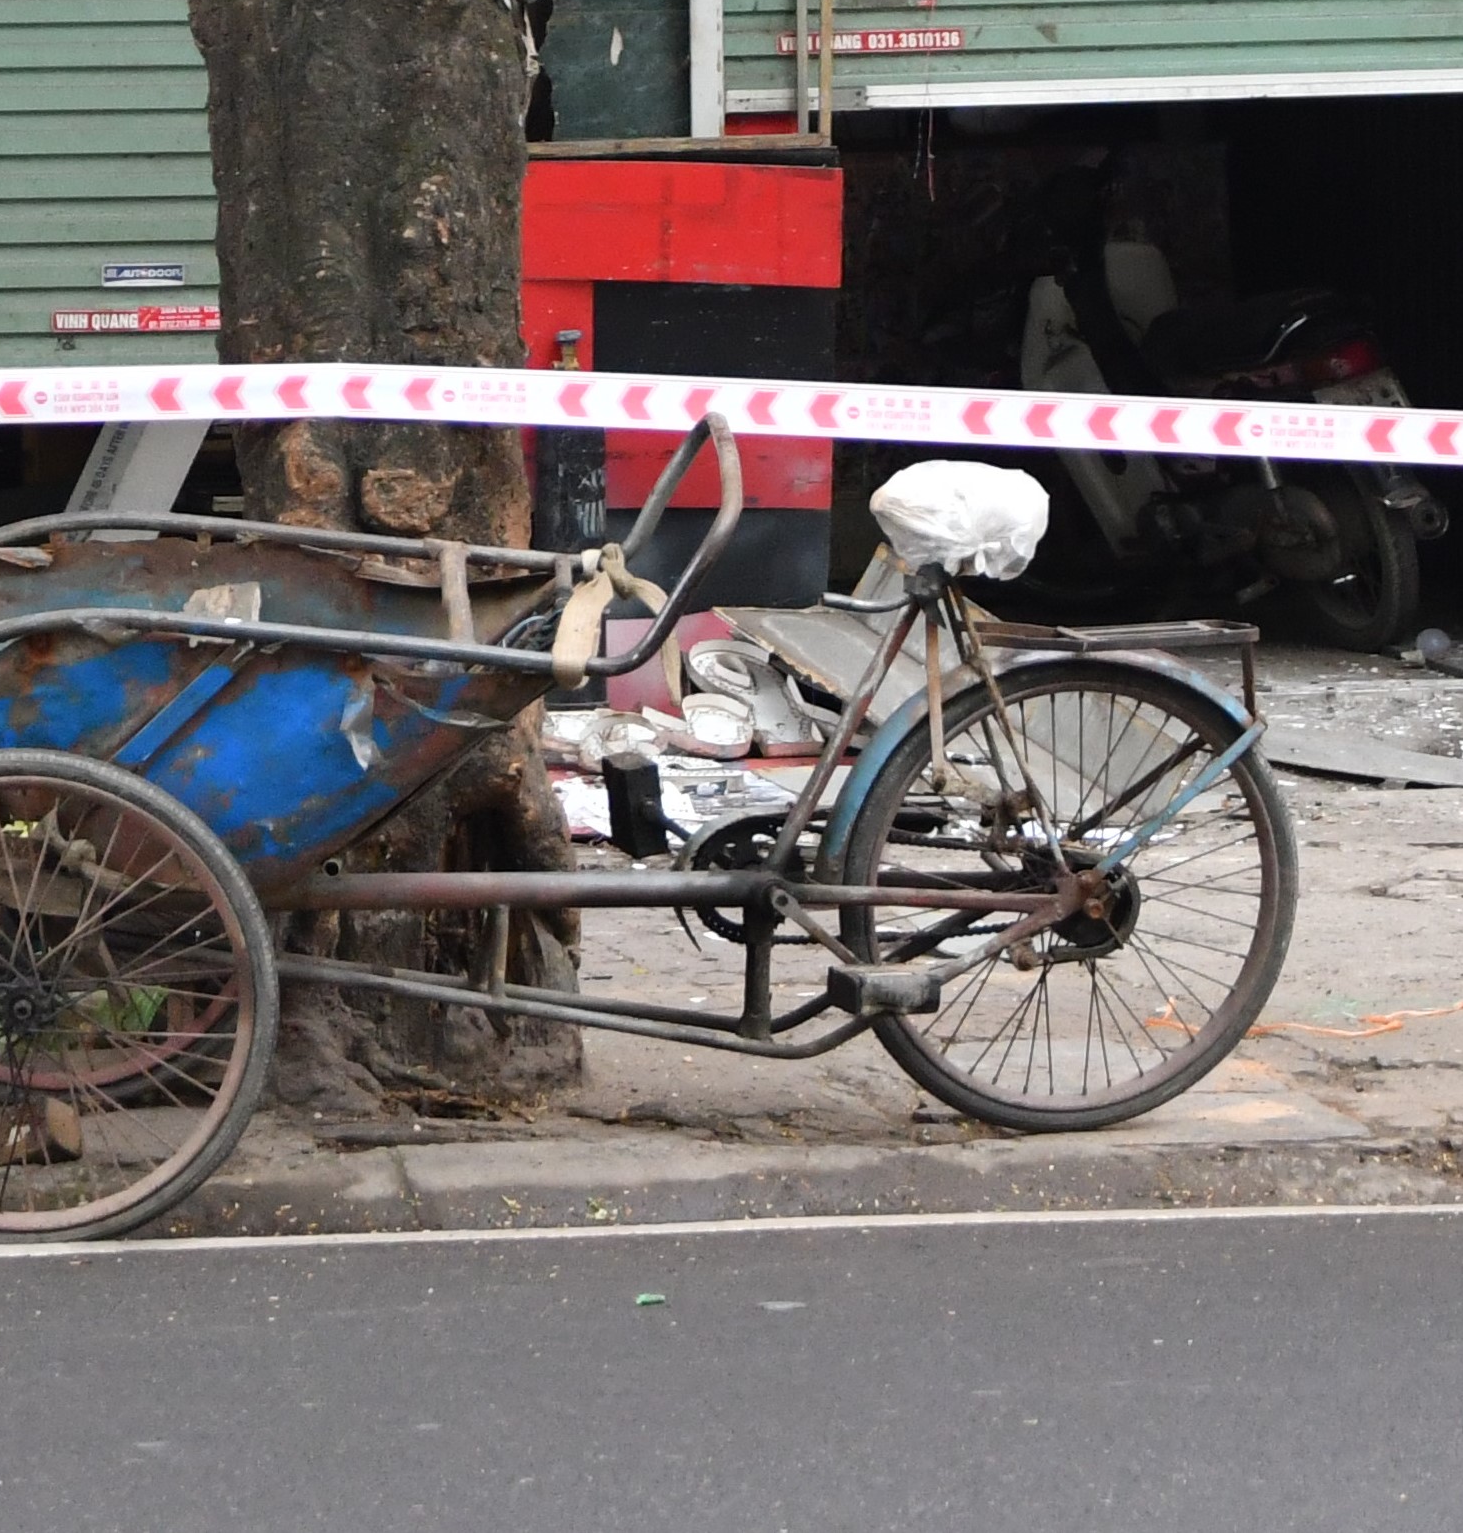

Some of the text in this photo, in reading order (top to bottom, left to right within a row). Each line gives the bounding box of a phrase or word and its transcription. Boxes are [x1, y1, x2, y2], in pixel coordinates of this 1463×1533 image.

[868, 31, 960, 49] 031.3610136
[56, 313, 88, 329] VINH
[92, 313, 138, 331] QUANG
